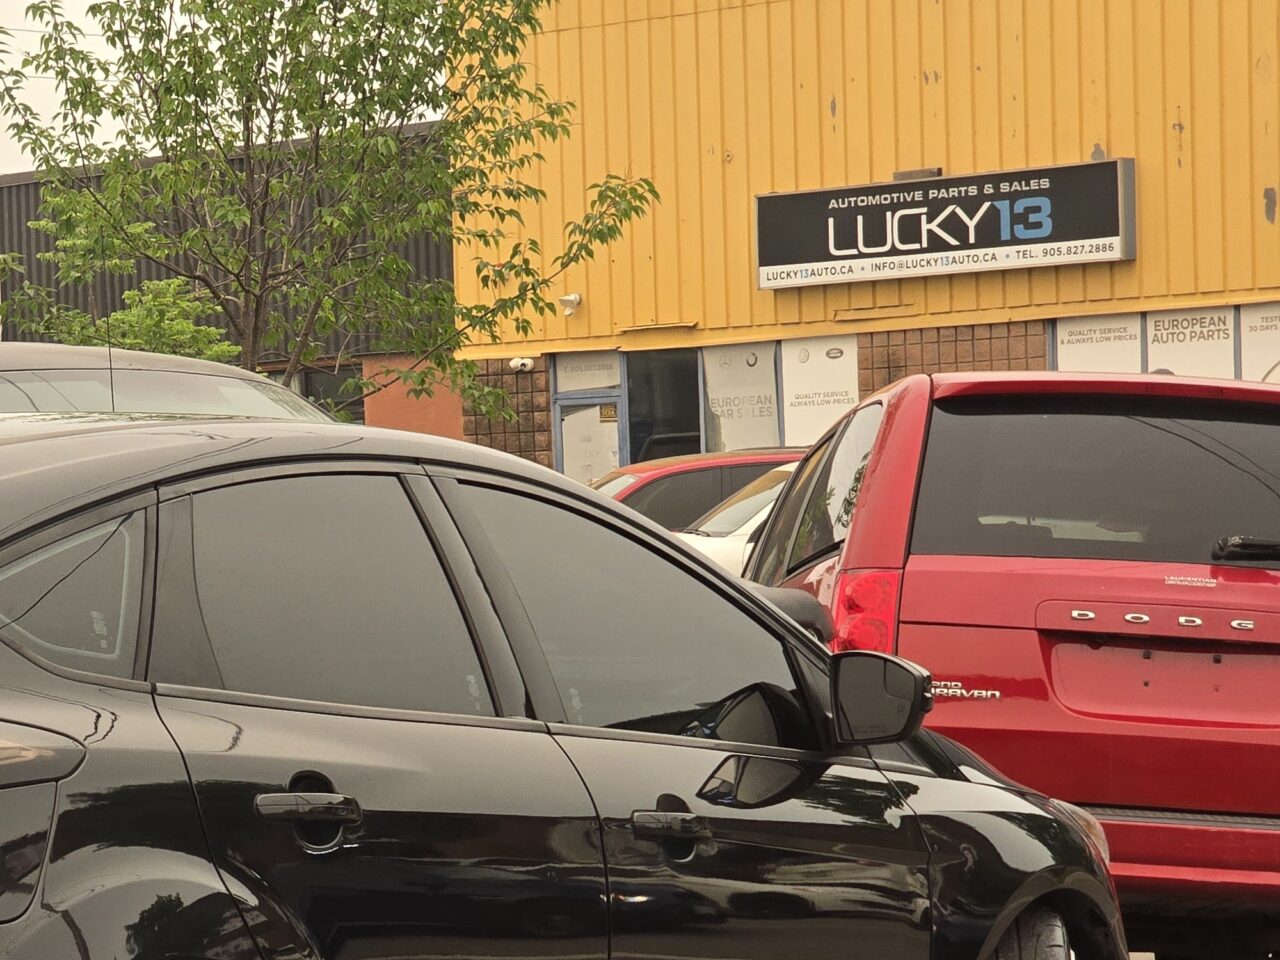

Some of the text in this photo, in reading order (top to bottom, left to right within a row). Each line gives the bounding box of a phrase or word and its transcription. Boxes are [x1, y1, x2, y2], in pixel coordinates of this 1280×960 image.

[828, 178, 1050, 209] AUTOMOTIVE PARTS & SALES
[828, 196, 1053, 256] LUCKY13
[766, 243, 1114, 281] LUCKY13AUTO.CA INFO@LUCKY13AUTO.CA TEL. 905.827.2886
[1154, 315, 1227, 332] EUROPEAN
[1067, 327, 1129, 337] QUALITY SERVICE
[1151, 328, 1230, 344] AUTO PARTS
[1066, 337, 1094, 345] ALWAYS
[794, 390, 849, 400] QUALITY SERVICE
[832, 397, 855, 405] PRICES
[931, 687, 1000, 698] RAVAN
